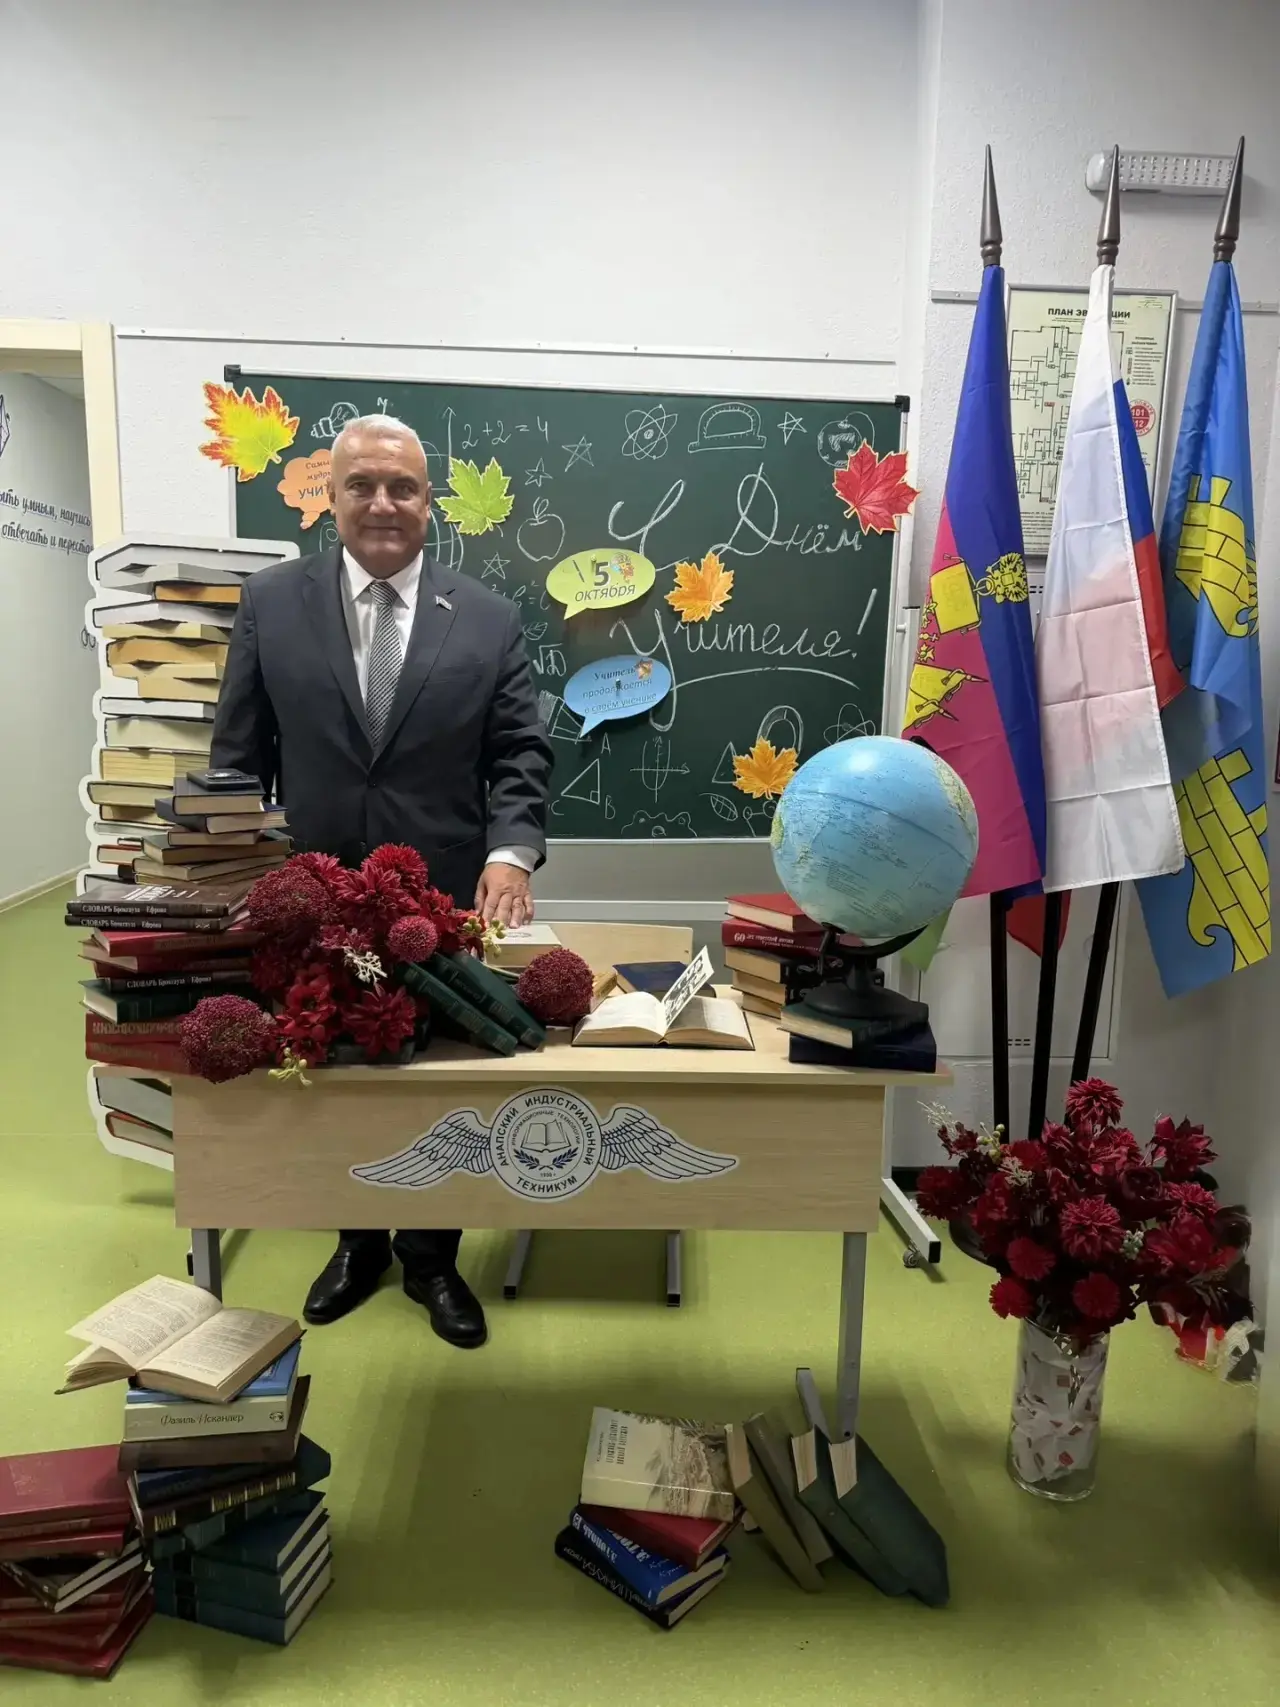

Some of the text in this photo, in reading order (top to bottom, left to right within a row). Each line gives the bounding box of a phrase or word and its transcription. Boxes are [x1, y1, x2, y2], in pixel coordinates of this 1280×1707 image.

[1048, 308, 1131, 318] ПЛАН ЭВЦИИ
[305, 460, 331, 469] Самы
[22, 497, 58, 520] умным,
[60, 508, 91, 526] научись
[706, 462, 862, 557] Днём
[2, 521, 48, 545] отвечать
[50, 535, 56, 547] и
[594, 561, 610, 586] 5
[82, 905, 112, 913] СЛОВАРЬ
[734, 932, 746, 942] 60
[495, 1095, 597, 1167] АНАПСКИЙ ИНДУСТРИАЛЬНЫЙ
[516, 1176, 577, 1193] ТЕХНИКУМ
[160, 1412, 244, 1427] Фазиль Искандер
